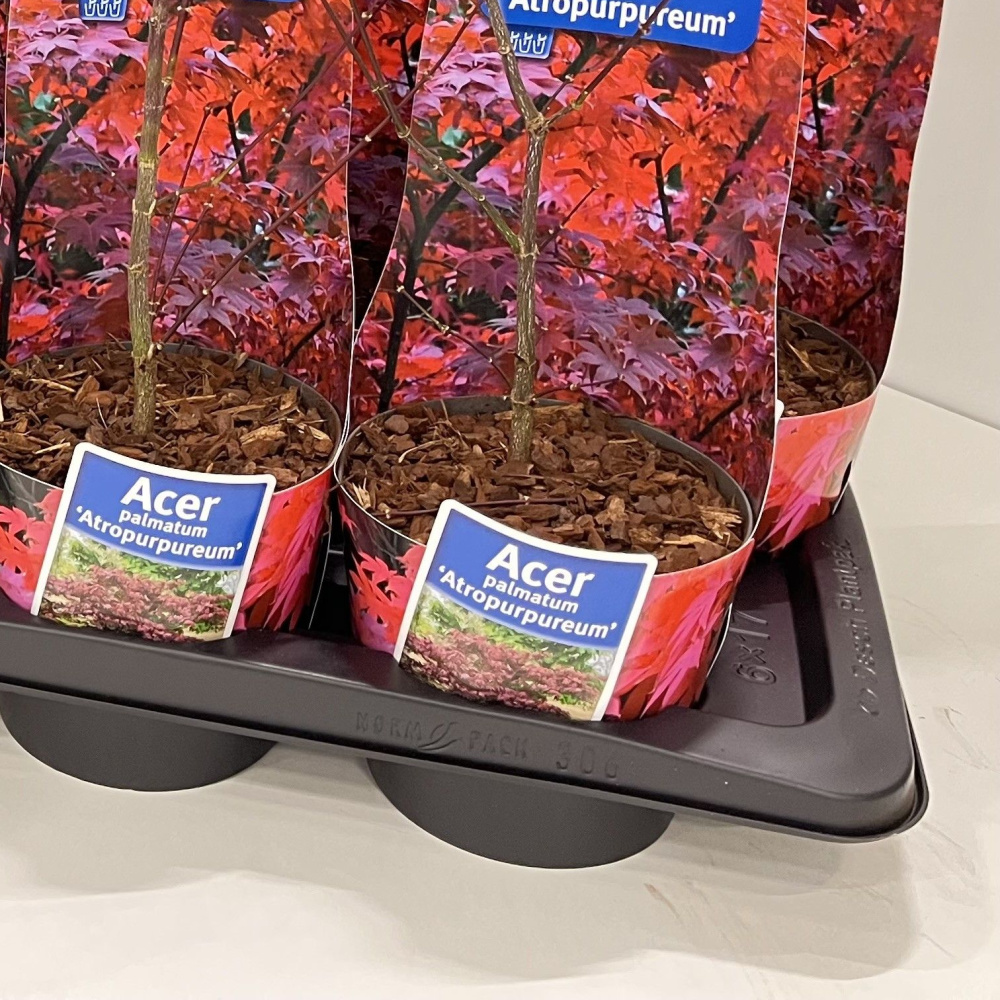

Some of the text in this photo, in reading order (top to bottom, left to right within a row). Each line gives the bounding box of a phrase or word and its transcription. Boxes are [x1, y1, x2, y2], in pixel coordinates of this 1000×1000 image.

[118, 509, 208, 539] palmatum
[119, 476, 222, 522] Acer
[76, 505, 243, 560] ‘Atropurpureum’
[483, 574, 580, 614] palmatum
[485, 542, 596, 598] Acer
[438, 565, 618, 639] ‘Atropurpureum’
